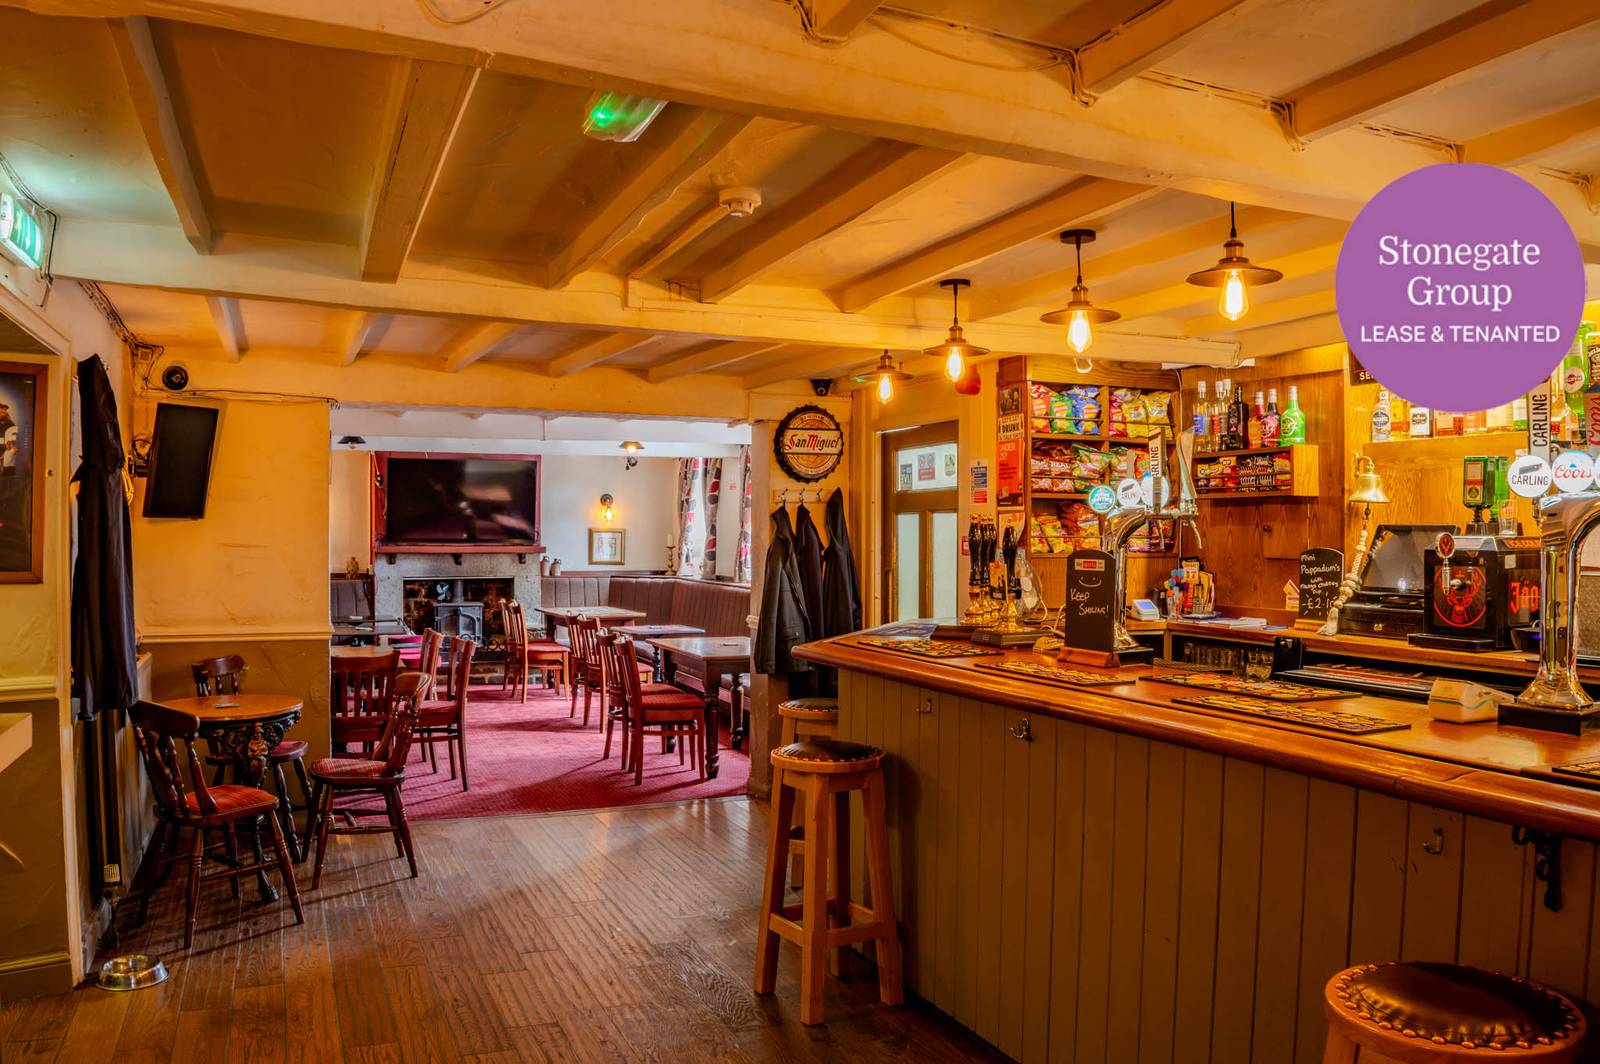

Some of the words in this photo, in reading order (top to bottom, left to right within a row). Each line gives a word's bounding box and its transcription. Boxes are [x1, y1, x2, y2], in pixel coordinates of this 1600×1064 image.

[1532, 394, 1548, 447] CARLING
[1150, 446, 1160, 478] ARLING
[1554, 464, 1592, 479] Coors
[1511, 474, 1548, 486] CARLING
